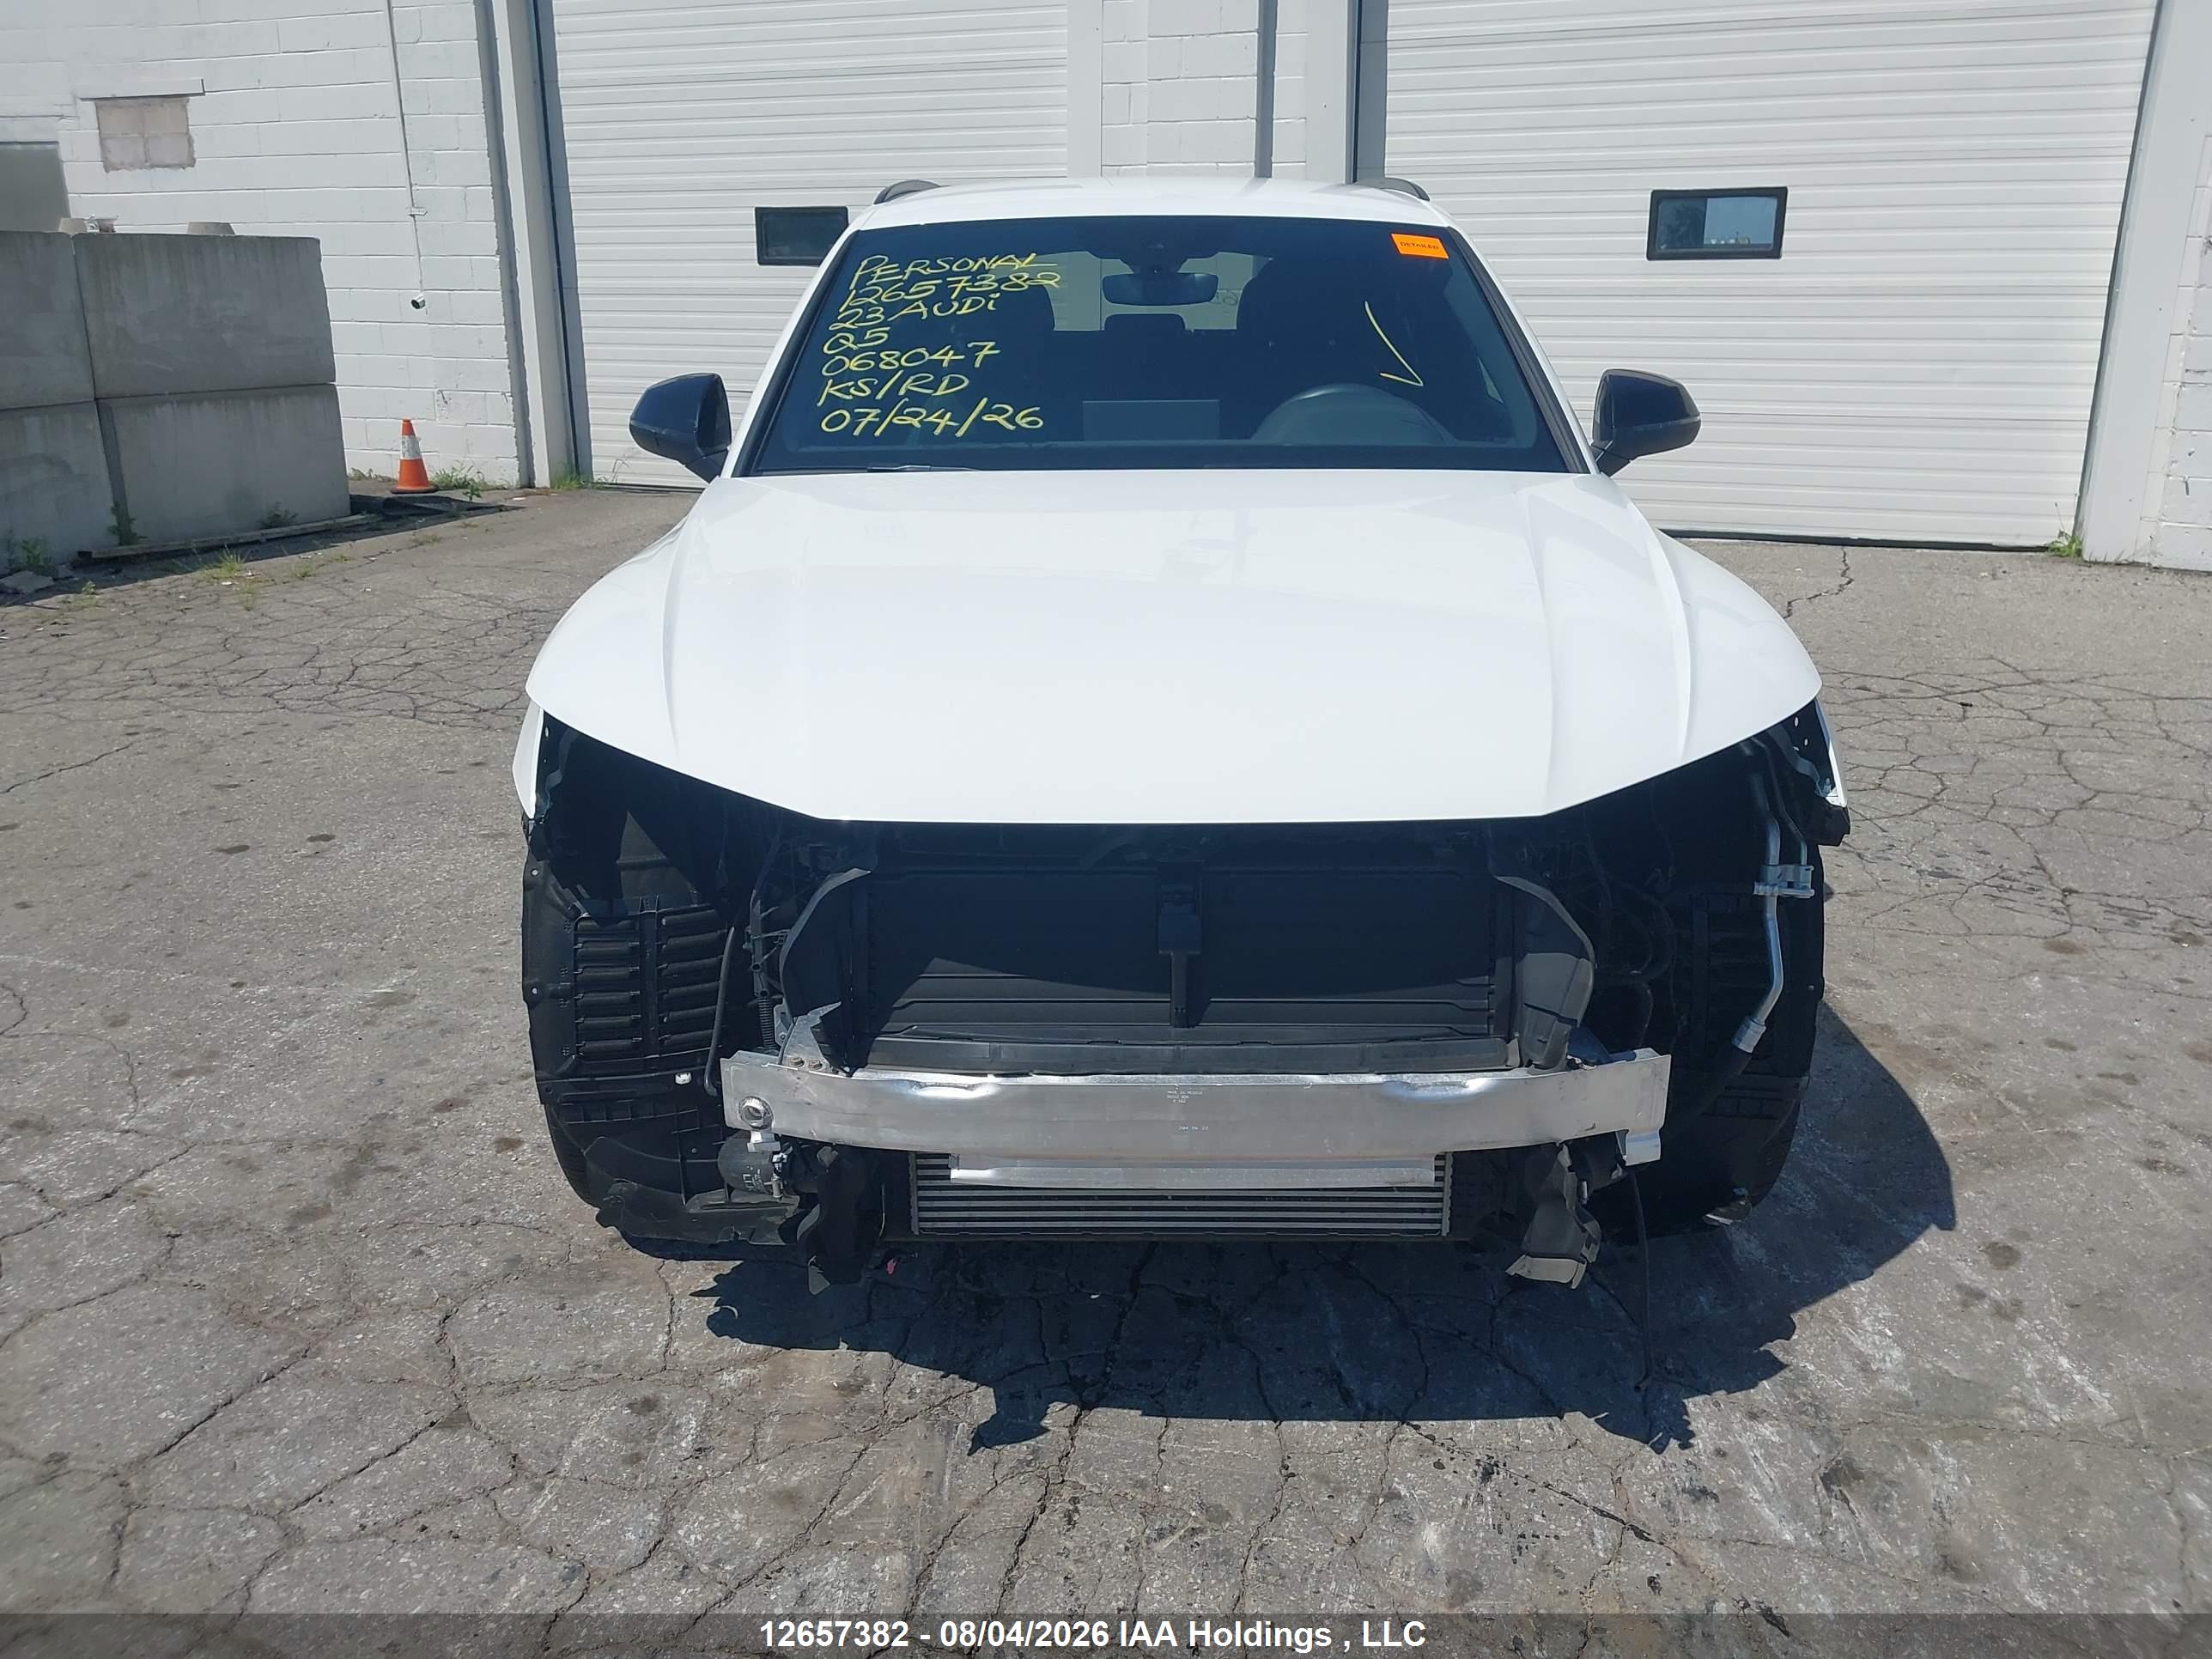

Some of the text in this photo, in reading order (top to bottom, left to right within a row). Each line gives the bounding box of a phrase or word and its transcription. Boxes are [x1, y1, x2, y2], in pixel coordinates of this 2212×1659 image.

[849, 252, 1058, 289] PERSONAL
[840, 271, 1061, 313] 12657382
[829, 307, 884, 330] 23
[822, 342, 1000, 376] 068047
[823, 327, 891, 355] Q5
[817, 369, 969, 406] KS/RD
[821, 398, 1043, 437] 07/24/26
